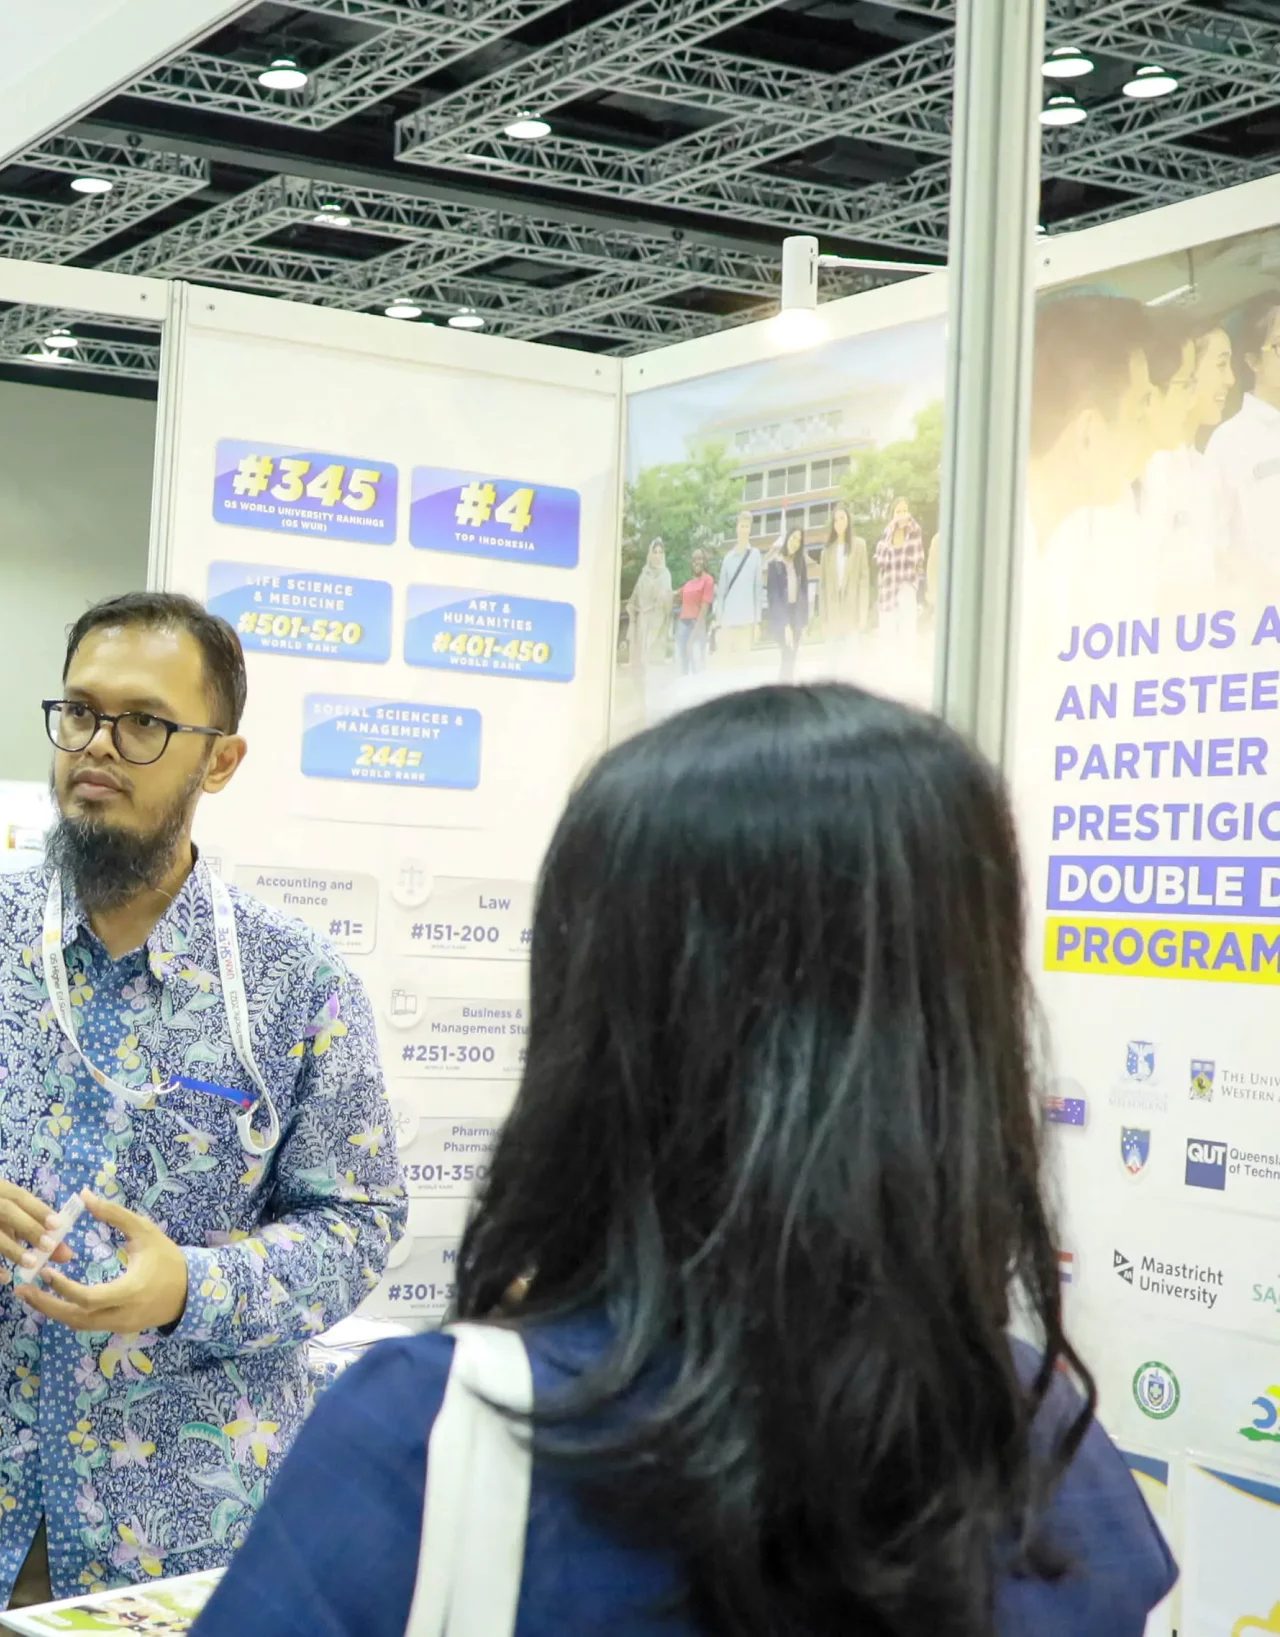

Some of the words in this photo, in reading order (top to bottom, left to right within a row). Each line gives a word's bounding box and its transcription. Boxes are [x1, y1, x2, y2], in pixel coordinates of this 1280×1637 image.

[231, 453, 381, 512] #345
[224, 500, 237, 509] QS
[240, 501, 275, 514] WORLD
[278, 507, 334, 522] UNIVERSITY
[336, 514, 385, 528] RANKINGS
[454, 480, 535, 533] #4
[454, 532, 476, 542] TOP
[479, 535, 535, 551] INDONESIA
[246, 575, 281, 588] LIFE
[287, 578, 354, 597] SCIENCE
[270, 592, 345, 611] MEDICINE
[468, 599, 497, 613] ART
[237, 611, 362, 645] #501-520
[443, 612, 533, 632] HUMANITIES
[261, 638, 302, 650] WORLD
[307, 642, 339, 654] RANK
[1057, 617, 1160, 662] JOIN
[1175, 610, 1236, 652] US
[432, 631, 550, 664] #401-450
[1055, 682, 1118, 722] AN
[313, 703, 370, 718] SOCIAL
[376, 708, 449, 725] SCIENCES
[336, 720, 441, 739] MANAGEMENT
[355, 744, 423, 769] 244=
[1054, 736, 1268, 782] PARTNER
[256, 874, 327, 892] Accounting
[330, 879, 353, 891] and
[1058, 864, 1244, 907] DOUBLE
[283, 892, 328, 906] finance
[479, 895, 511, 910] Law
[329, 919, 363, 936] #1=
[410, 922, 500, 943] #151-200
[462, 1007, 512, 1019] Business
[515, 1008, 523, 1019] &
[431, 1022, 506, 1035] Management
[402, 1045, 495, 1062] #251-300
[1221, 1085, 1275, 1102] WESTERN
[1188, 1143, 1226, 1166] QUT
[1230, 1148, 1280, 1165] Queensl
[1229, 1164, 1240, 1174] of
[1140, 1256, 1224, 1286] Maastricht
[1140, 1275, 1218, 1309] University
[1252, 1284, 1280, 1304] SA
